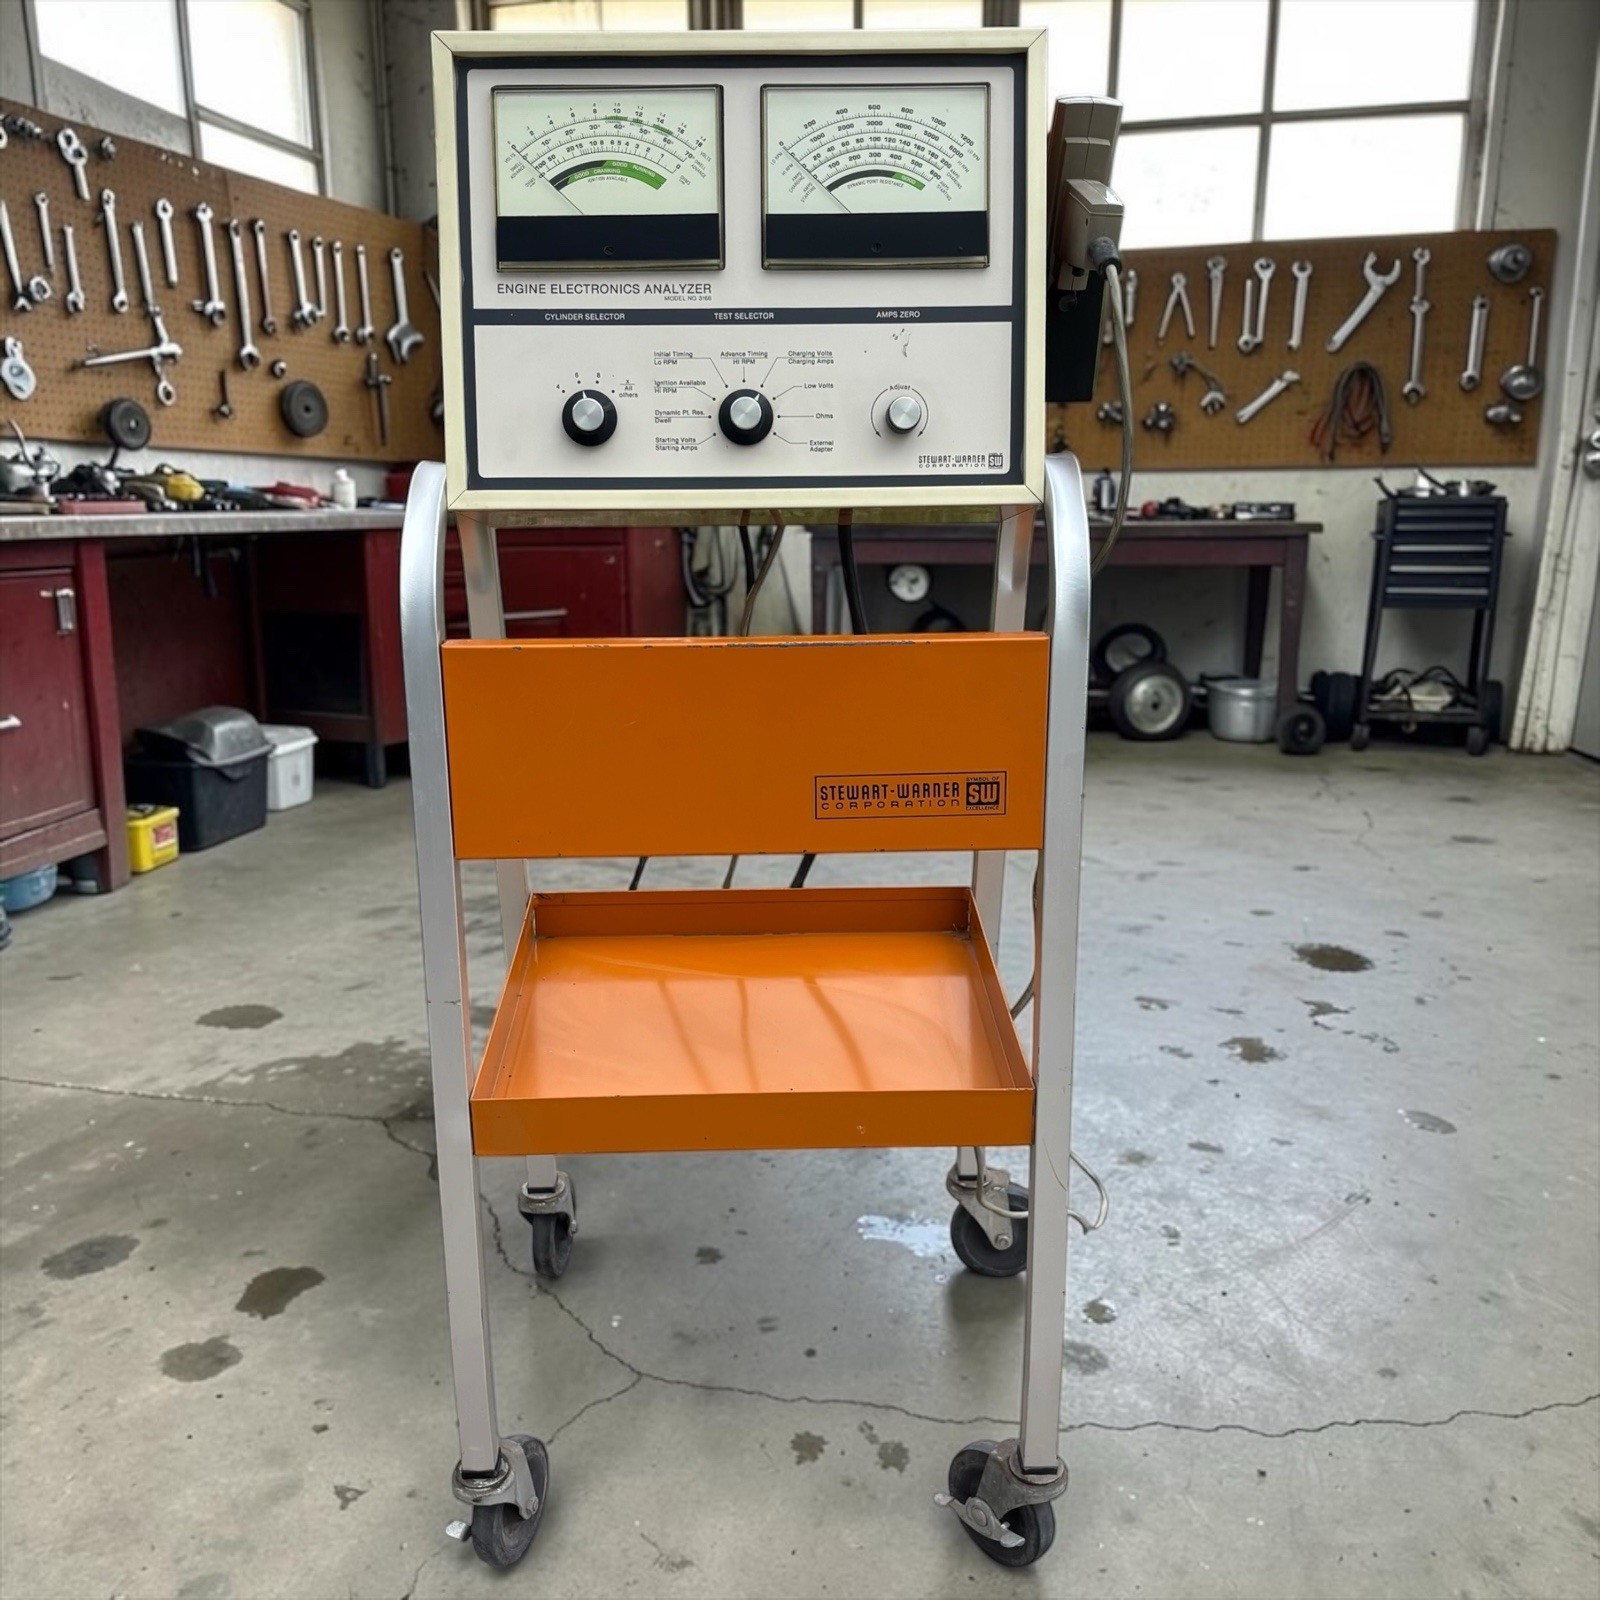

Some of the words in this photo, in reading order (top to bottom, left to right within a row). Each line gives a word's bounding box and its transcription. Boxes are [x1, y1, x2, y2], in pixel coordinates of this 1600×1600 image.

[804, 119, 816, 130] 200
[930, 116, 946, 128] 1000
[960, 134, 974, 147] 1200
[810, 132, 826, 143] 1000
[838, 123, 854, 131] 2000
[895, 122, 912, 130] 4000
[924, 130, 940, 141] 5000
[812, 152, 822, 160] 20
[914, 143, 926, 152] 160
[940, 158, 952, 169] 200
[828, 160, 840, 170] 100
[910, 159, 924, 168] 500
[930, 169, 942, 180] 600
[847, 180, 866, 189] DYNAMIC
[880, 180, 904, 188] RESISTANCE
[497, 284, 546, 294] ENGINE
[550, 284, 640, 294] ELECTRONICS
[644, 284, 712, 294] ANALYZER
[544, 313, 584, 321] CYLINDER
[734, 312, 774, 320] SELECTOR
[656, 436, 680, 444] Starting
[918, 454, 986, 464] STEWART-WARNER
[988, 455, 1003, 468] SW
[820, 782, 960, 801] STEWART-WARNER
[967, 784, 998, 804] SW
[821, 799, 960, 810] CORPORATION
